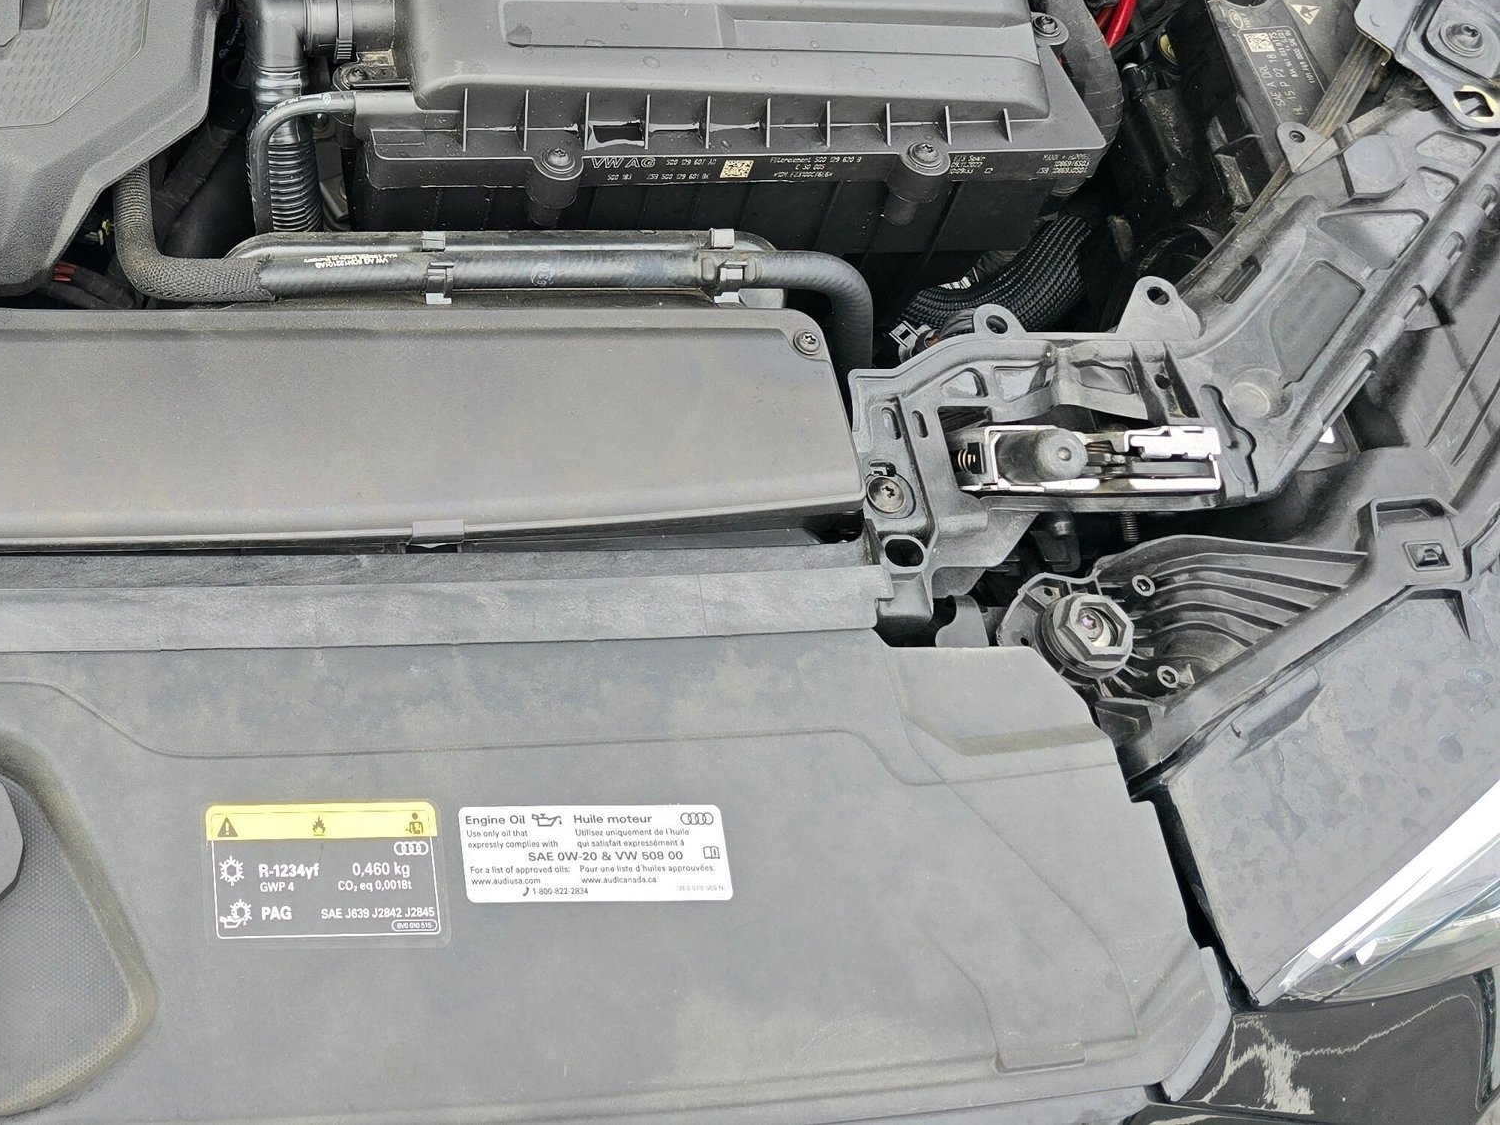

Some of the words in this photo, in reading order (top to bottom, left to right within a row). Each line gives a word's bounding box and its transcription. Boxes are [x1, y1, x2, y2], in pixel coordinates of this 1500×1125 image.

[1266, 54, 1278, 63] 18
[1259, 65, 1273, 79] DRL
[1273, 67, 1286, 78] P2
[1271, 91, 1286, 107] SAE
[1284, 90, 1297, 100] 15
[591, 156, 625, 169] VW
[624, 156, 657, 169] AG
[465, 815, 505, 826] Engine
[509, 815, 526, 824] Oil
[573, 814, 604, 824] Huile
[607, 815, 653, 824] moteur
[466, 830, 482, 838] Use
[483, 829, 499, 838] only
[501, 829, 511, 837] oil
[512, 829, 528, 837] that
[575, 828, 603, 837] Utilisez
[605, 828, 652, 837] uniquement
[654, 828, 664, 836] de
[467, 841, 504, 849] expressly
[505, 840, 540, 849] complies
[541, 840, 559, 848] with
[576, 840, 590, 849] qui
[591, 839, 622, 847] satisfait
[528, 852, 554, 861] SAE
[557, 851, 598, 861] 0W-20
[601, 851, 612, 861] &
[615, 851, 638, 860] VW
[641, 851, 664, 860] 508
[668, 851, 684, 860] 00
[258, 863, 320, 880] R-1234yf
[352, 862, 390, 878] 0,460
[393, 862, 411, 880] kg
[470, 866, 483, 874] For
[491, 865, 504, 874] list
[505, 865, 514, 874] of
[515, 865, 553, 874] approved
[554, 865, 571, 873] oils:
[579, 865, 598, 873] Pour
[616, 865, 633, 873] liste
[471, 877, 541, 885] www.audiusa.com
[580, 876, 657, 884] www.audicanada.ca
[259, 882, 286, 893] GWP
[287, 881, 295, 892] 4
[359, 882, 373, 893] eq
[261, 906, 292, 921] PAG
[321, 908, 343, 919] SAE
[345, 908, 370, 919] J639
[372, 907, 402, 919] J2842
[404, 906, 435, 918] J2845
